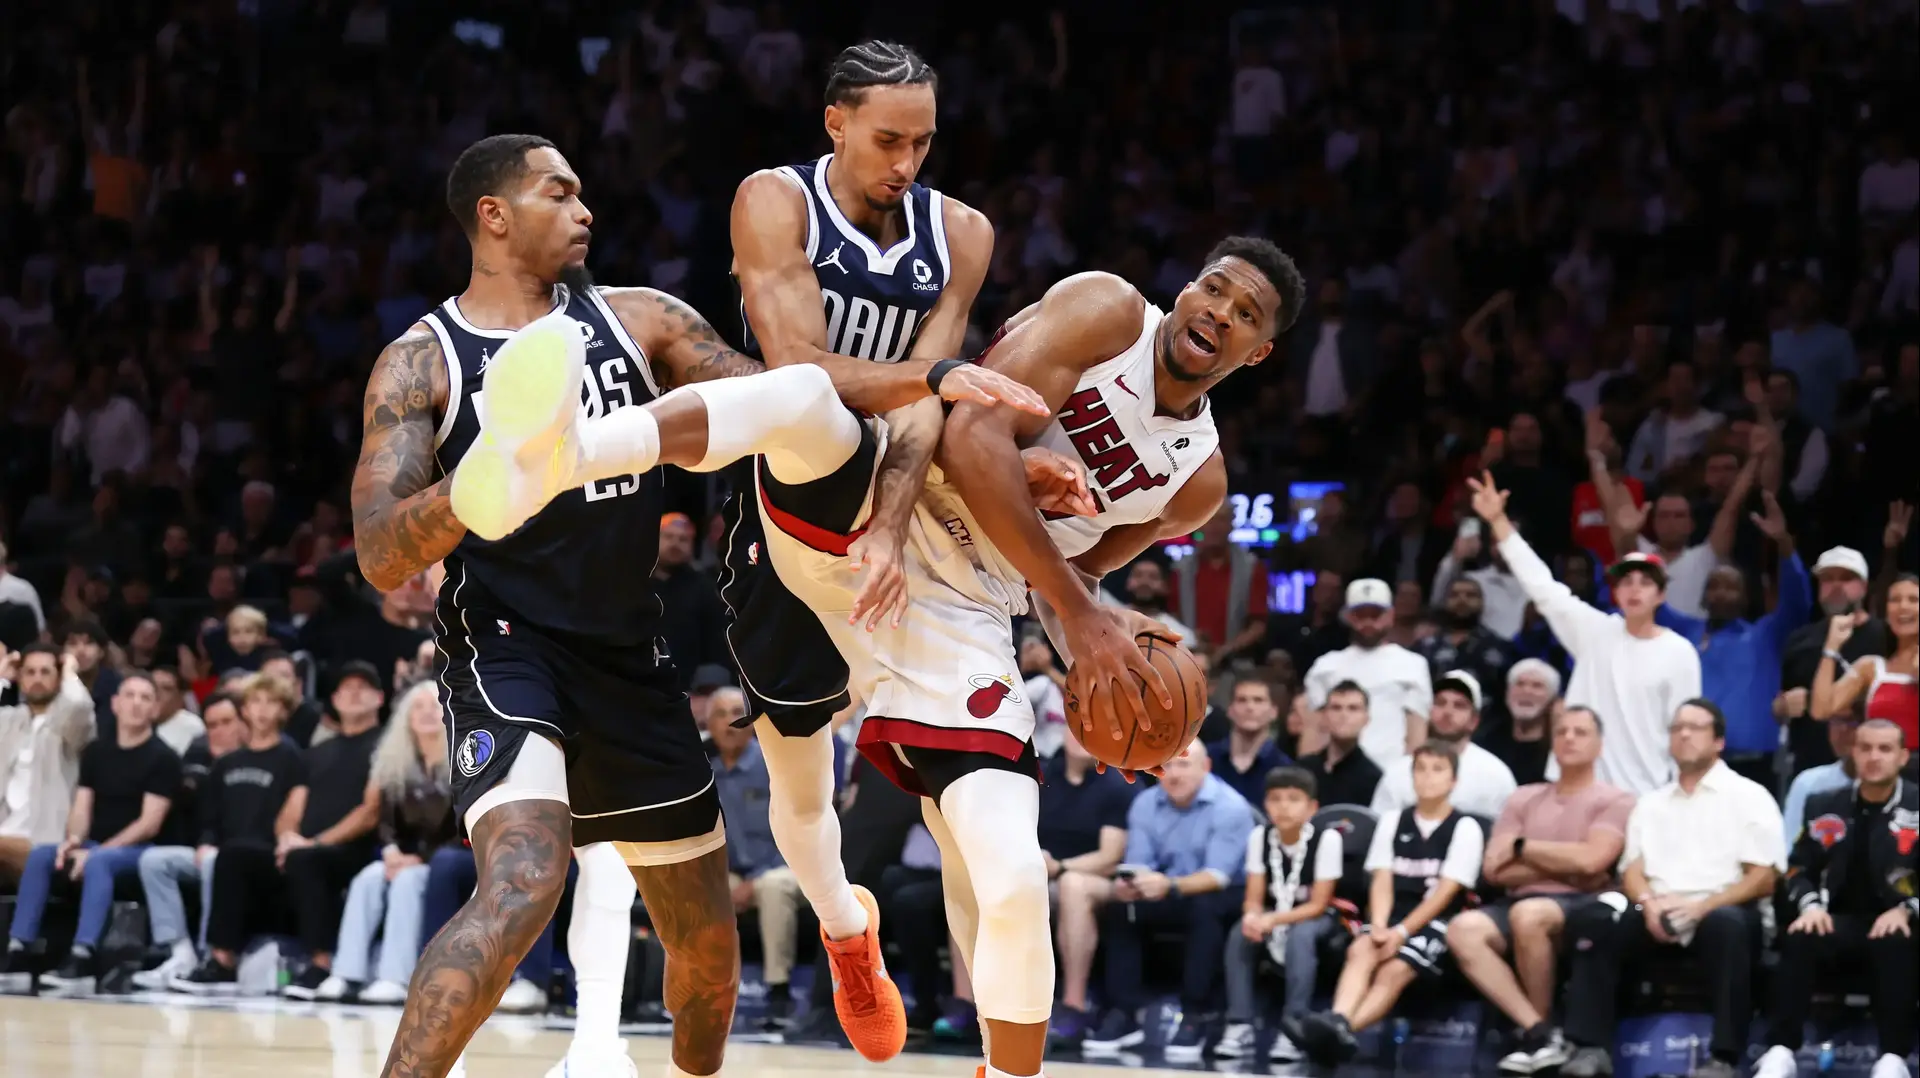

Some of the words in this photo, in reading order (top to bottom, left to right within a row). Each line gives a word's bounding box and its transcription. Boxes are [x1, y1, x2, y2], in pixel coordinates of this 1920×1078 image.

[912, 282, 940, 292] CHASE
[585, 339, 605, 350] ASE
[1057, 386, 1170, 503] HEAT
[1160, 440, 1180, 473] Robinhood
